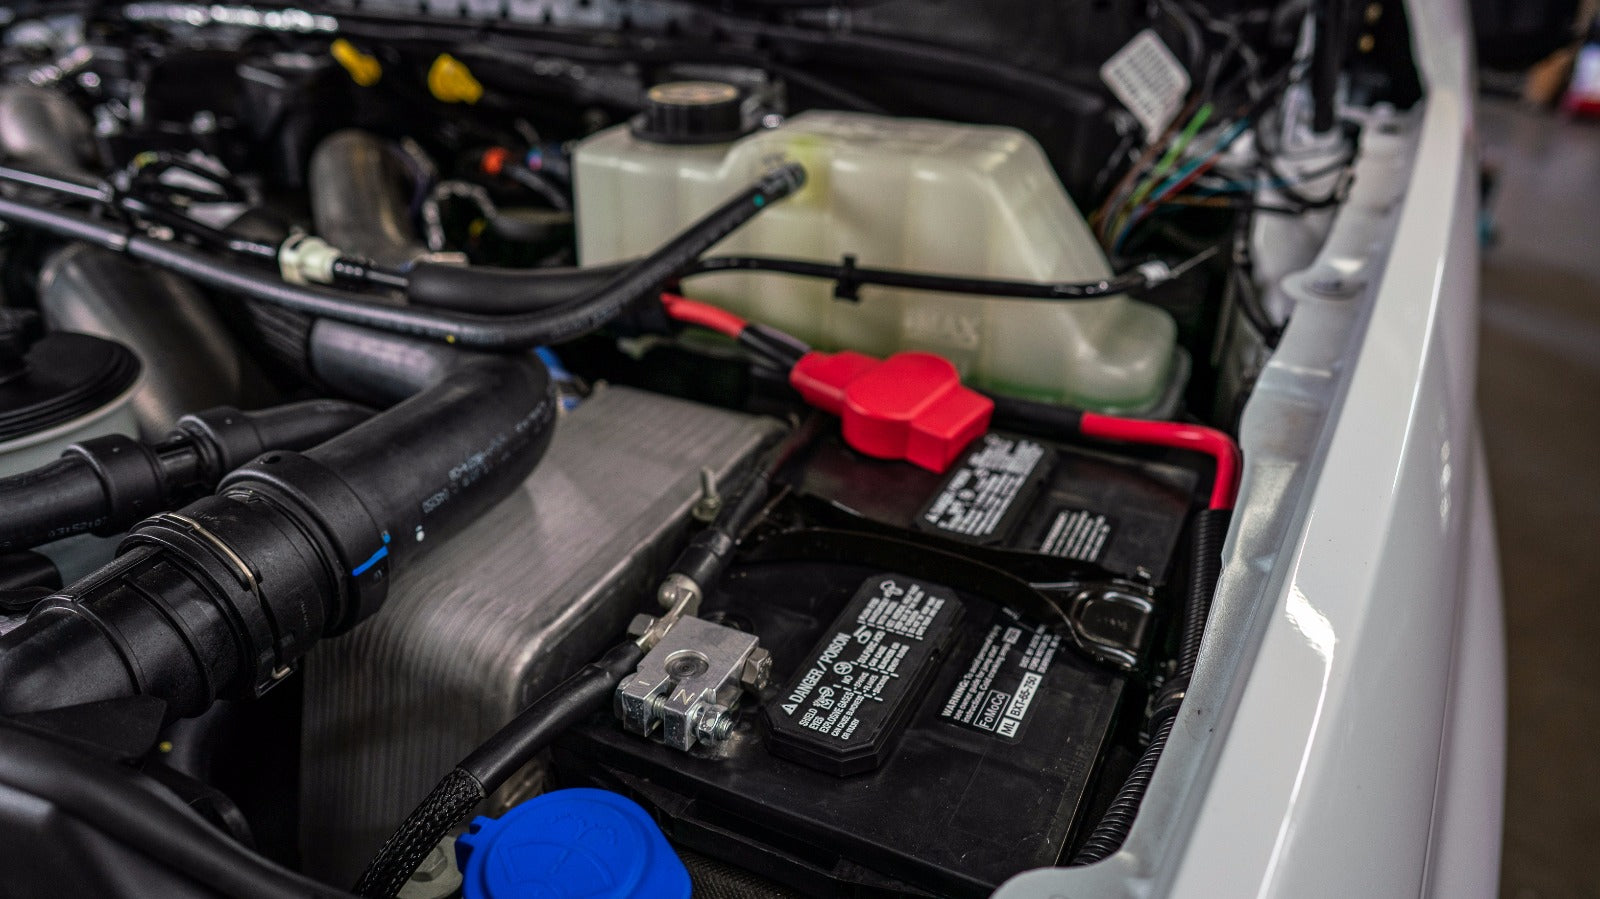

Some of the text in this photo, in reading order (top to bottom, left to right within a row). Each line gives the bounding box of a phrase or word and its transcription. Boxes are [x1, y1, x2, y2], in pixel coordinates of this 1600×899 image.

[856, 640, 878, 663] SULFURIC
[871, 630, 886, 642] ACID
[868, 657, 878, 666] CAN
[788, 667, 824, 703] DANGER
[818, 631, 851, 663] POISON
[841, 674, 853, 683] NO
[862, 674, 878, 689] FLAMES
[941, 678, 969, 717] WARNING:
[952, 709, 963, 720] see
[959, 692, 972, 709] owner
[967, 677, 980, 693] guide
[975, 670, 985, 678] for
[961, 689, 985, 723] instructions.
[979, 677, 991, 690] Cold
[978, 691, 1006, 728] FoMoCo
[1000, 719, 1016, 734] ML
[1009, 674, 1037, 716] BXT-65-750
[798, 708, 818, 726] SHIELD
[808, 715, 824, 730] EYES
[818, 691, 854, 733] EXPLOSIVE GASES
[830, 727, 841, 736] CAN
[836, 715, 850, 727] CAUSE
[840, 731, 850, 739] OR
